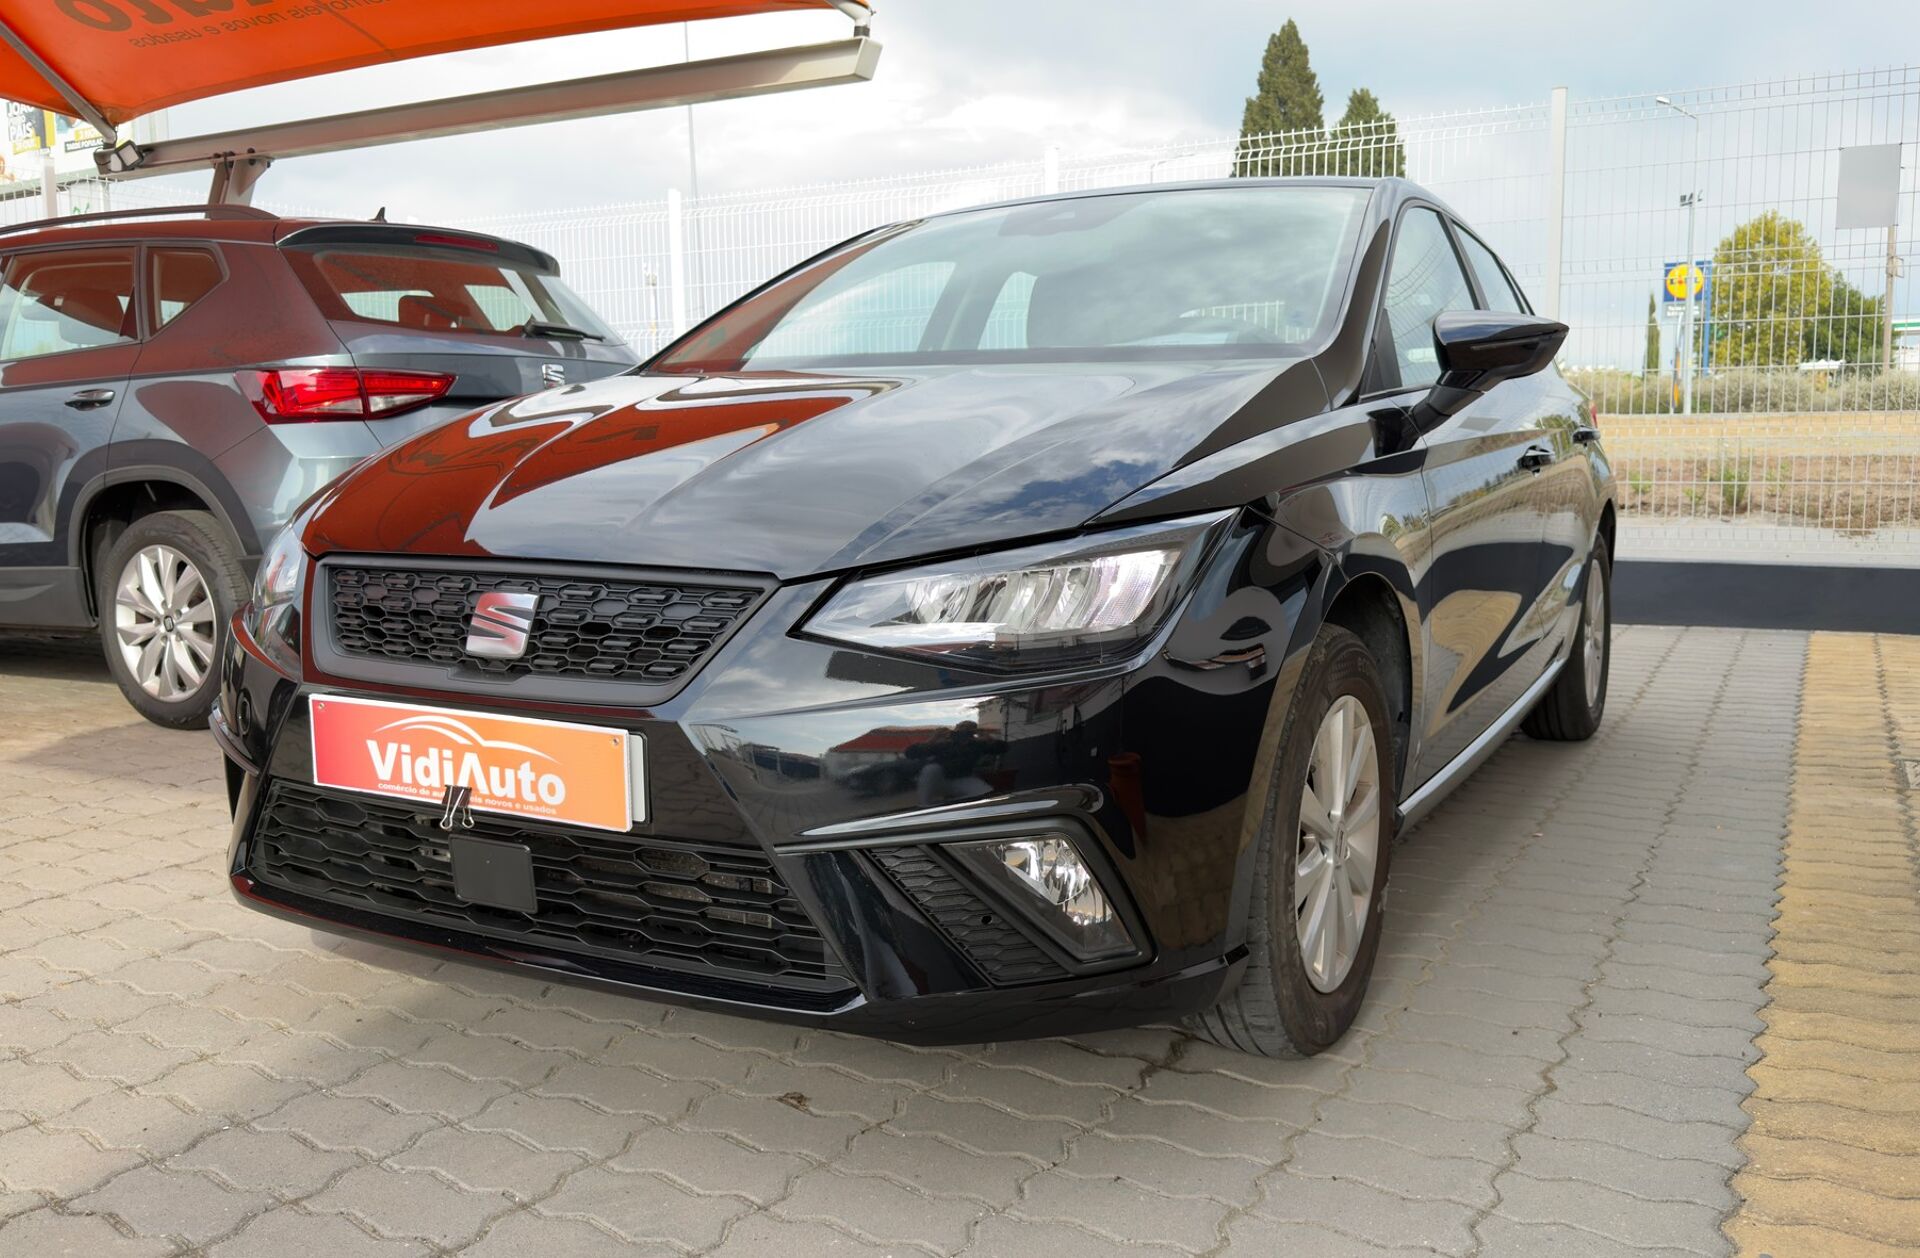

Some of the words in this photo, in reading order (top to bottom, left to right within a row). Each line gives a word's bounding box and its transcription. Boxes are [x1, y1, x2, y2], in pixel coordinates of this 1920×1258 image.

[366, 739, 566, 805] VidiAuto
[419, 787, 430, 795] de
[485, 798, 513, 807] novos
[523, 803, 557, 815] usados
